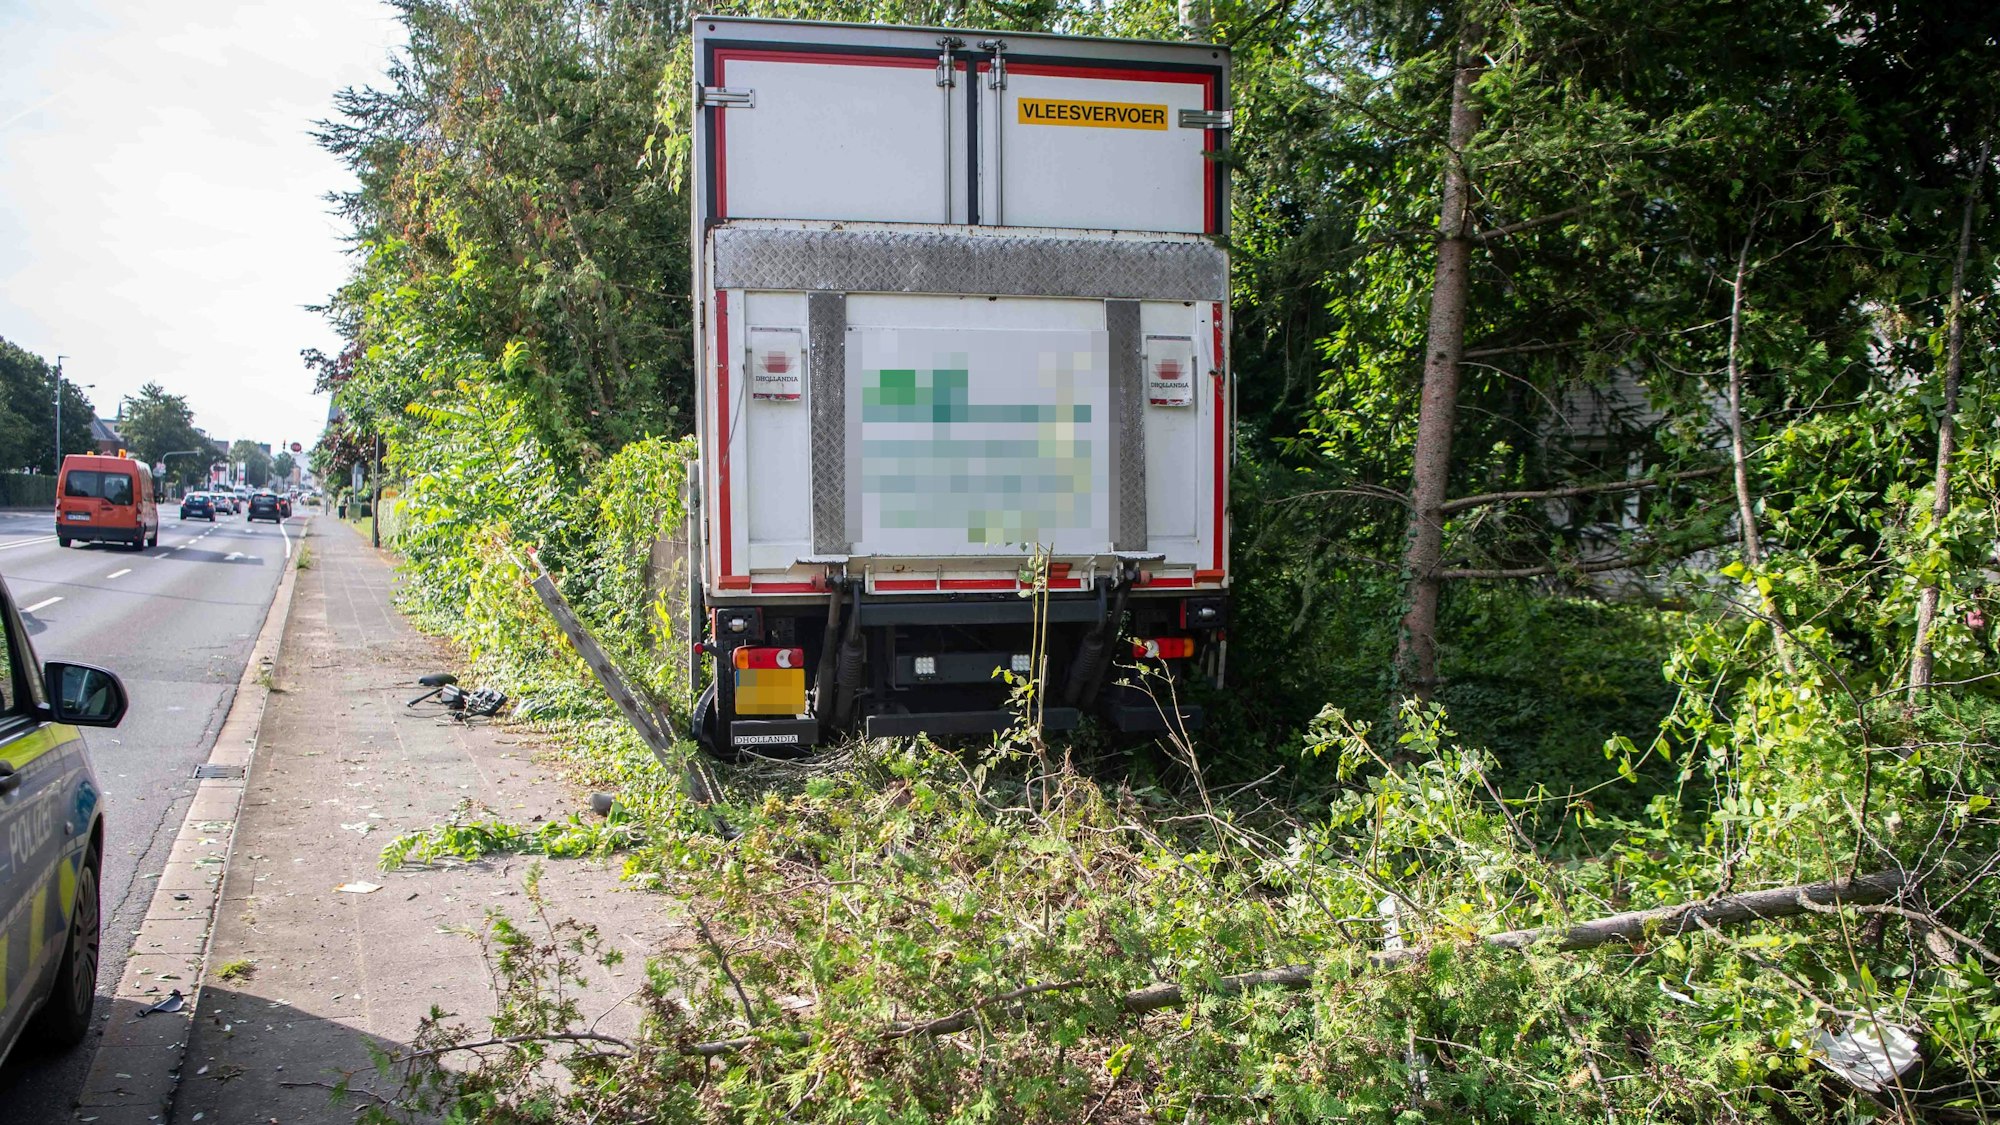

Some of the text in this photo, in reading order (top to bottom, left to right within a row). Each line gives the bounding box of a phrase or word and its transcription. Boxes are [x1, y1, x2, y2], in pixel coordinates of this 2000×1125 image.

[1023, 103, 1165, 124] VLEESVERVOER
[735, 735, 797, 744] DHOLLANDIA
[9, 796, 52, 874] POLIZEI
